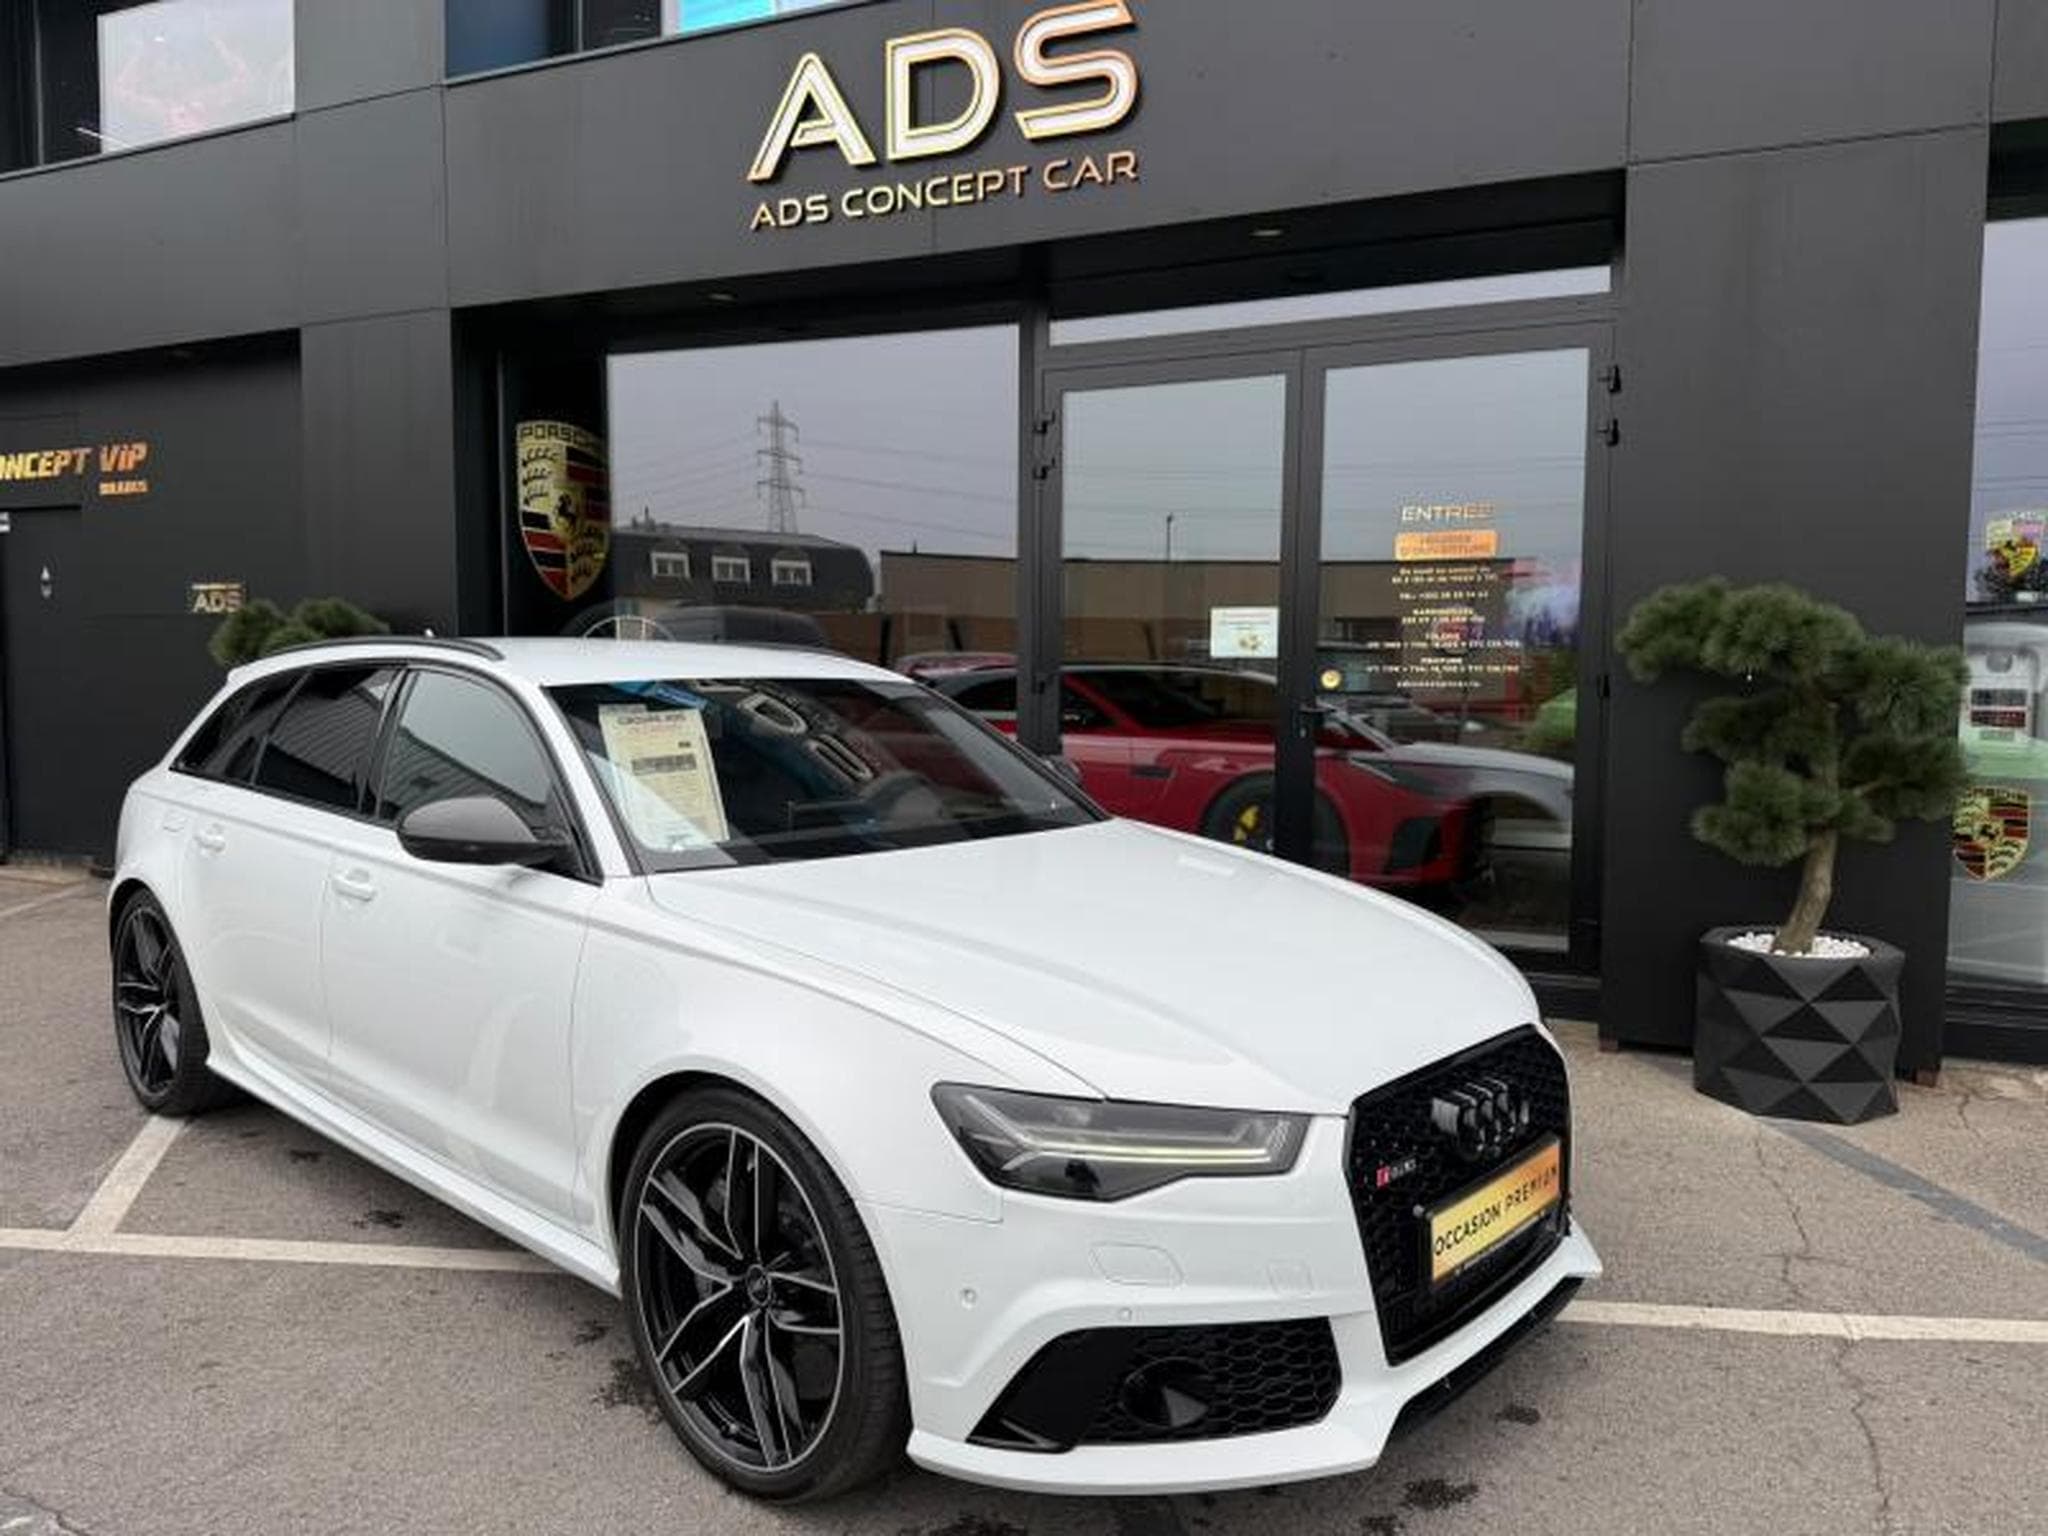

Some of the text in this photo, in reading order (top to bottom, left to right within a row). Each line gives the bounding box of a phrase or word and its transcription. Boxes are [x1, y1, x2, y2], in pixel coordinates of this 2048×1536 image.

[747, 0, 1137, 182] ADS
[750, 151, 1138, 231] ADS CONCEPT CAR
[192, 591, 243, 613] ADS
[1434, 1201, 1502, 1257] OCCASION
